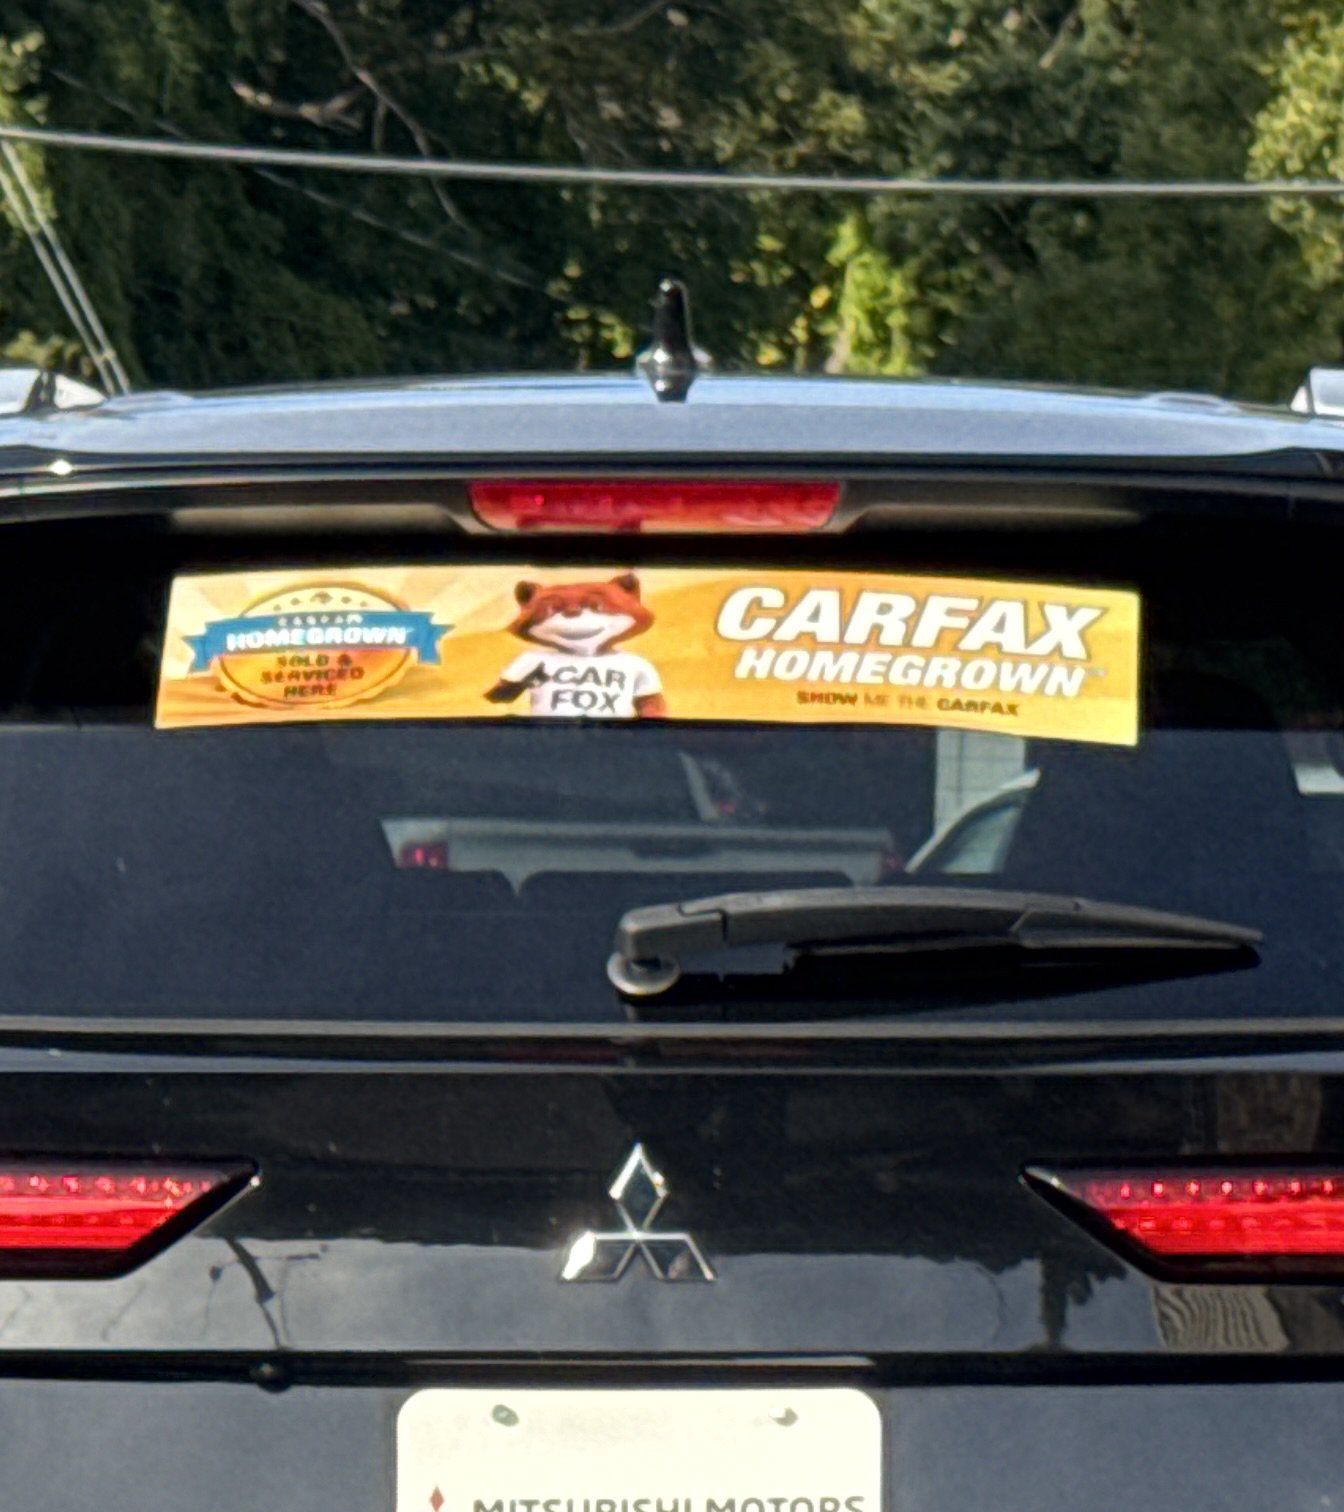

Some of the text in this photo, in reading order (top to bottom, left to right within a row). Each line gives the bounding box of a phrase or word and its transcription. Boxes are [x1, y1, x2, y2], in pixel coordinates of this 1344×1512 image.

[715, 586, 1104, 660] CARFAX
[225, 626, 407, 651] HOMEGROWN
[551, 665, 626, 691] CAR
[733, 647, 1087, 698] HOMEGROWN
[550, 689, 620, 712] FOX
[936, 697, 1020, 717] CARFAX
